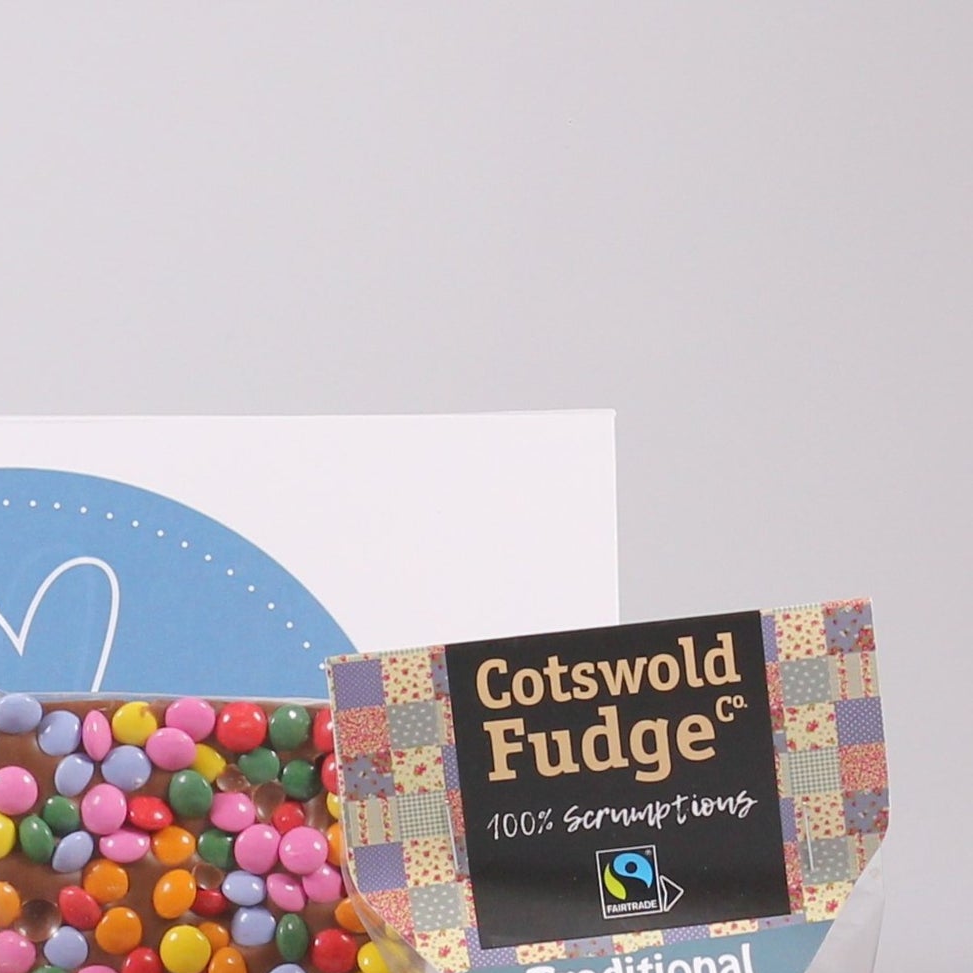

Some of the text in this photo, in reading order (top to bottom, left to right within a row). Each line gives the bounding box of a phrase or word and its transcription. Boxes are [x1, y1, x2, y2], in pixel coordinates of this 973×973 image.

[476, 632, 741, 710] Cotswold
[483, 705, 716, 782] Fudge
[487, 808, 554, 841] 100%
[607, 899, 659, 914] FAIRTRADE
